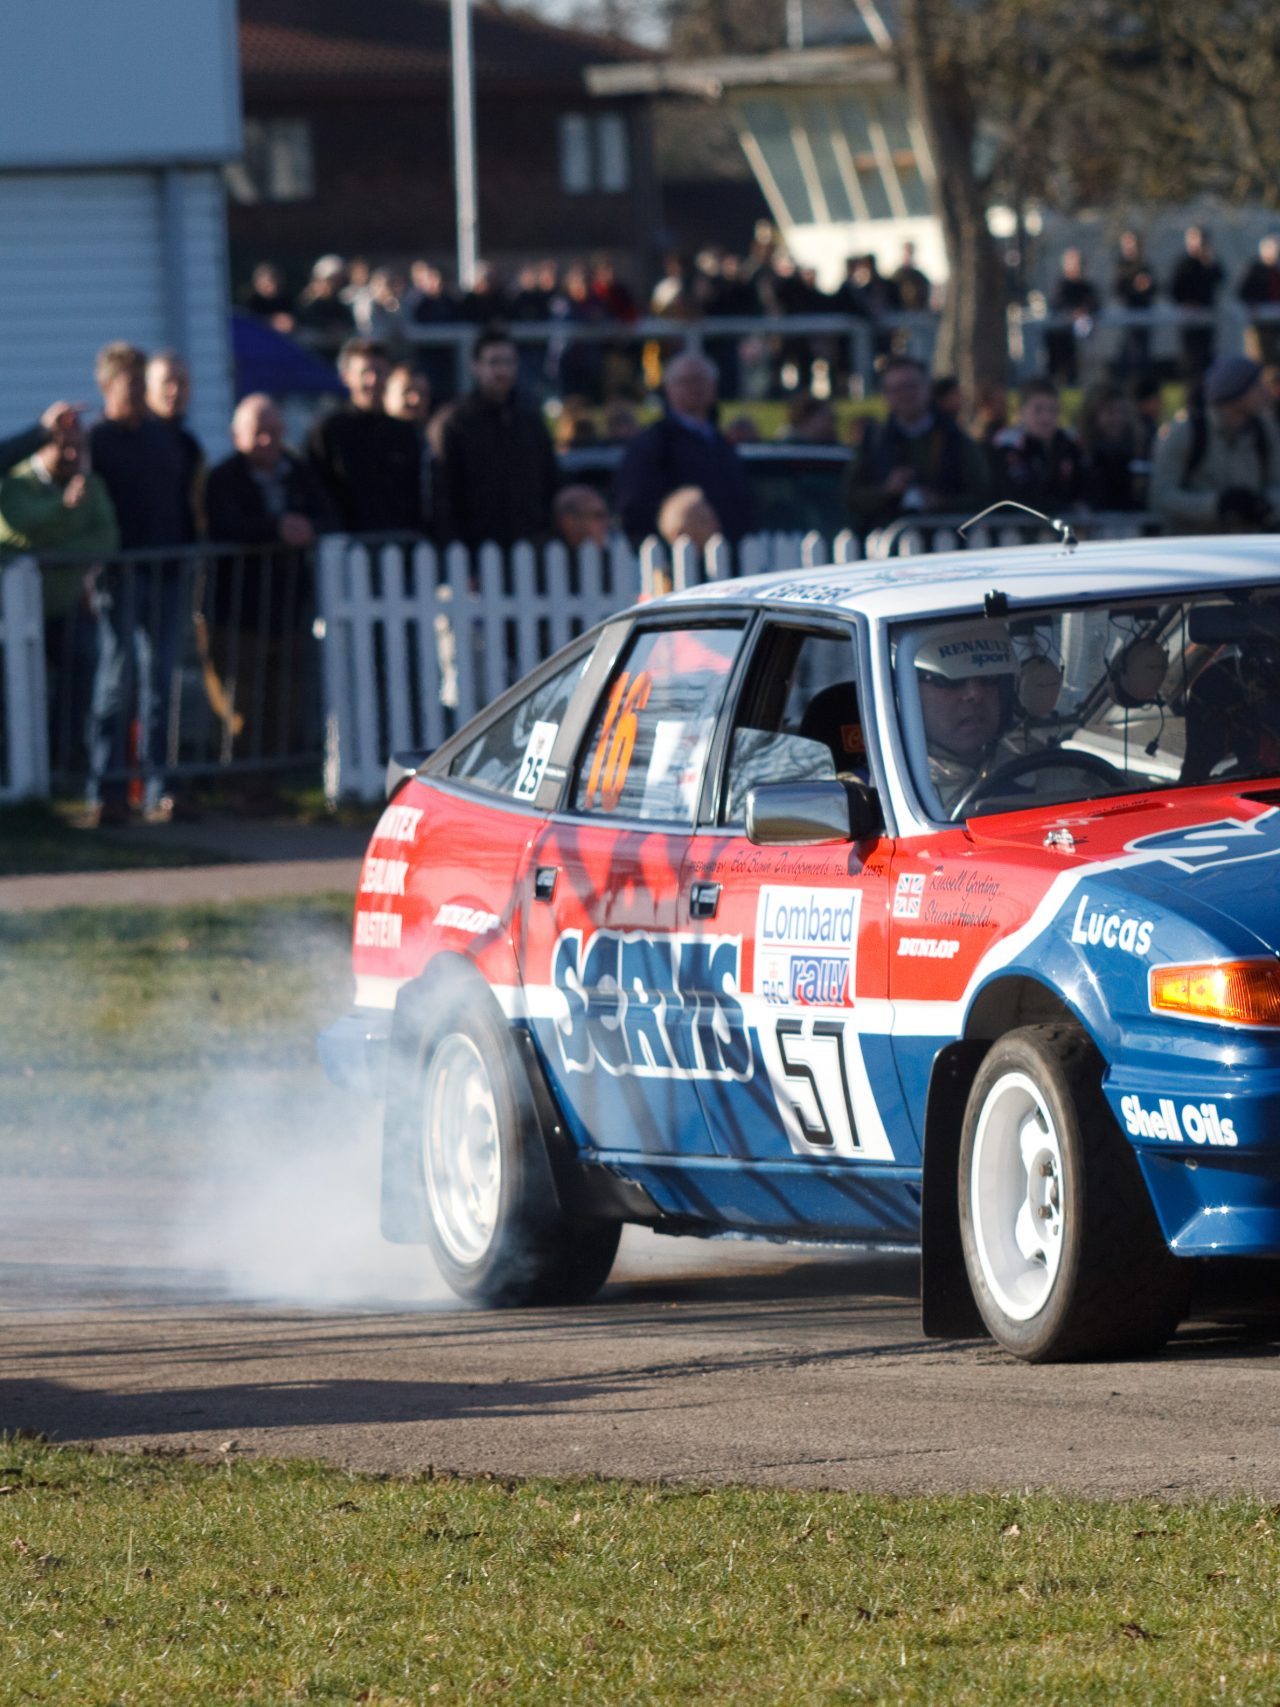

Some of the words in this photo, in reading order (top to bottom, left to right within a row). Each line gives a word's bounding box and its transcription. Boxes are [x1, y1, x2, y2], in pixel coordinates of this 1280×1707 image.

[519, 756, 543, 794] 25
[762, 892, 855, 942] Lombard
[1071, 895, 1155, 956] Lucas
[897, 937, 960, 959] DUNLOP
[790, 958, 849, 1005] rally
[776, 1018, 861, 1149] 57
[1120, 1094, 1181, 1143] Shell
[1181, 1103, 1239, 1147] Oils
